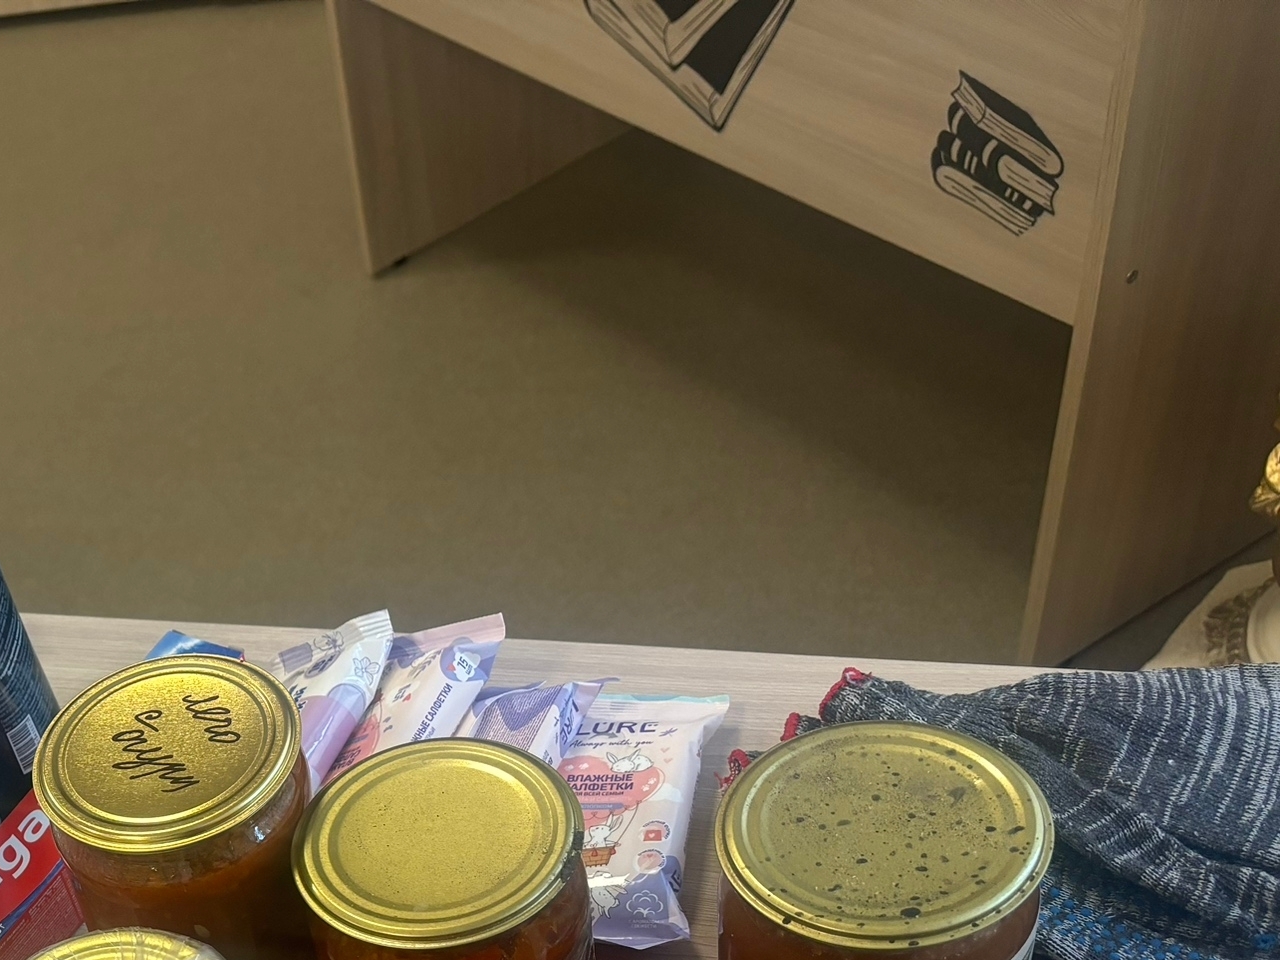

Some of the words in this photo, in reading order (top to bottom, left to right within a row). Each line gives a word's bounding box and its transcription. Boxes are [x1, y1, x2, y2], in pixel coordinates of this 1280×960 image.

[425, 683, 453, 723] САЛФЕТКИ
[568, 738, 606, 750] Always
[609, 738, 633, 748] with
[634, 740, 655, 751] you
[567, 773, 634, 783] ВЛАЖНЫЕ
